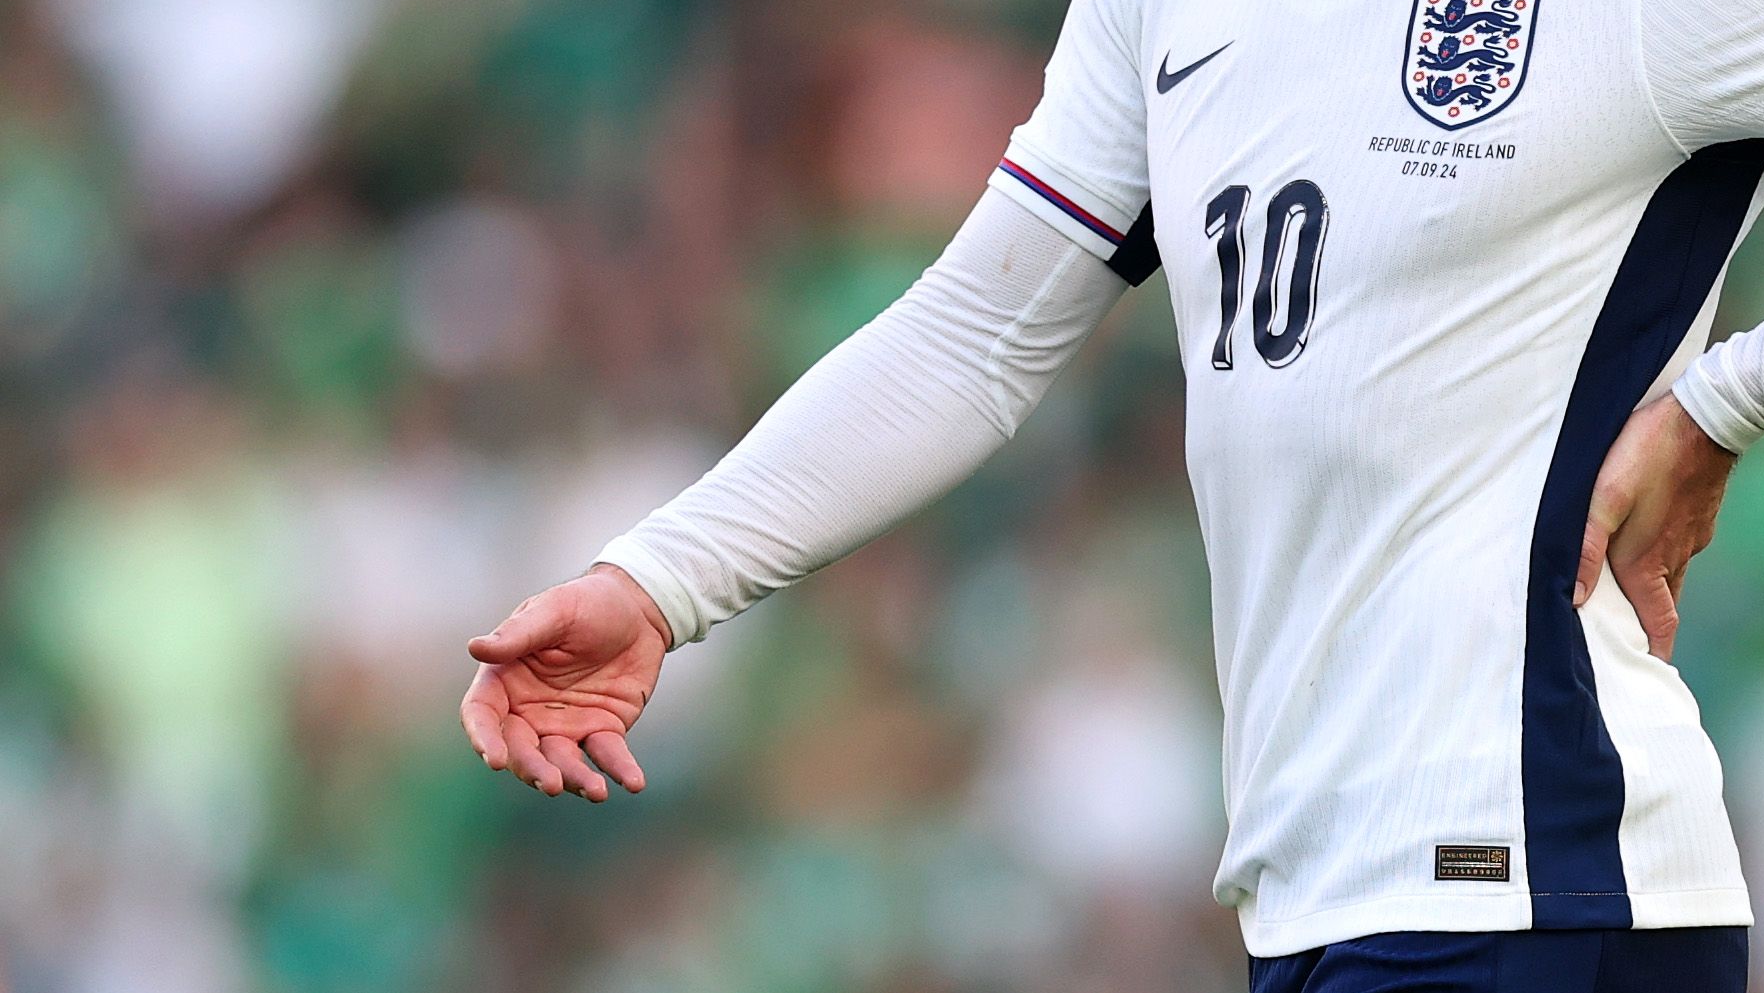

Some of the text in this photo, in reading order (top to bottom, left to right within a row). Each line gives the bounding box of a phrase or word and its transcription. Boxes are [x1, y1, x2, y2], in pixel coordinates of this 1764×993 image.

[1368, 136, 1516, 159] REPUBLIC OF IRELAND
[1401, 160, 1458, 179] 07.09.24
[1205, 179, 1330, 370] 10
